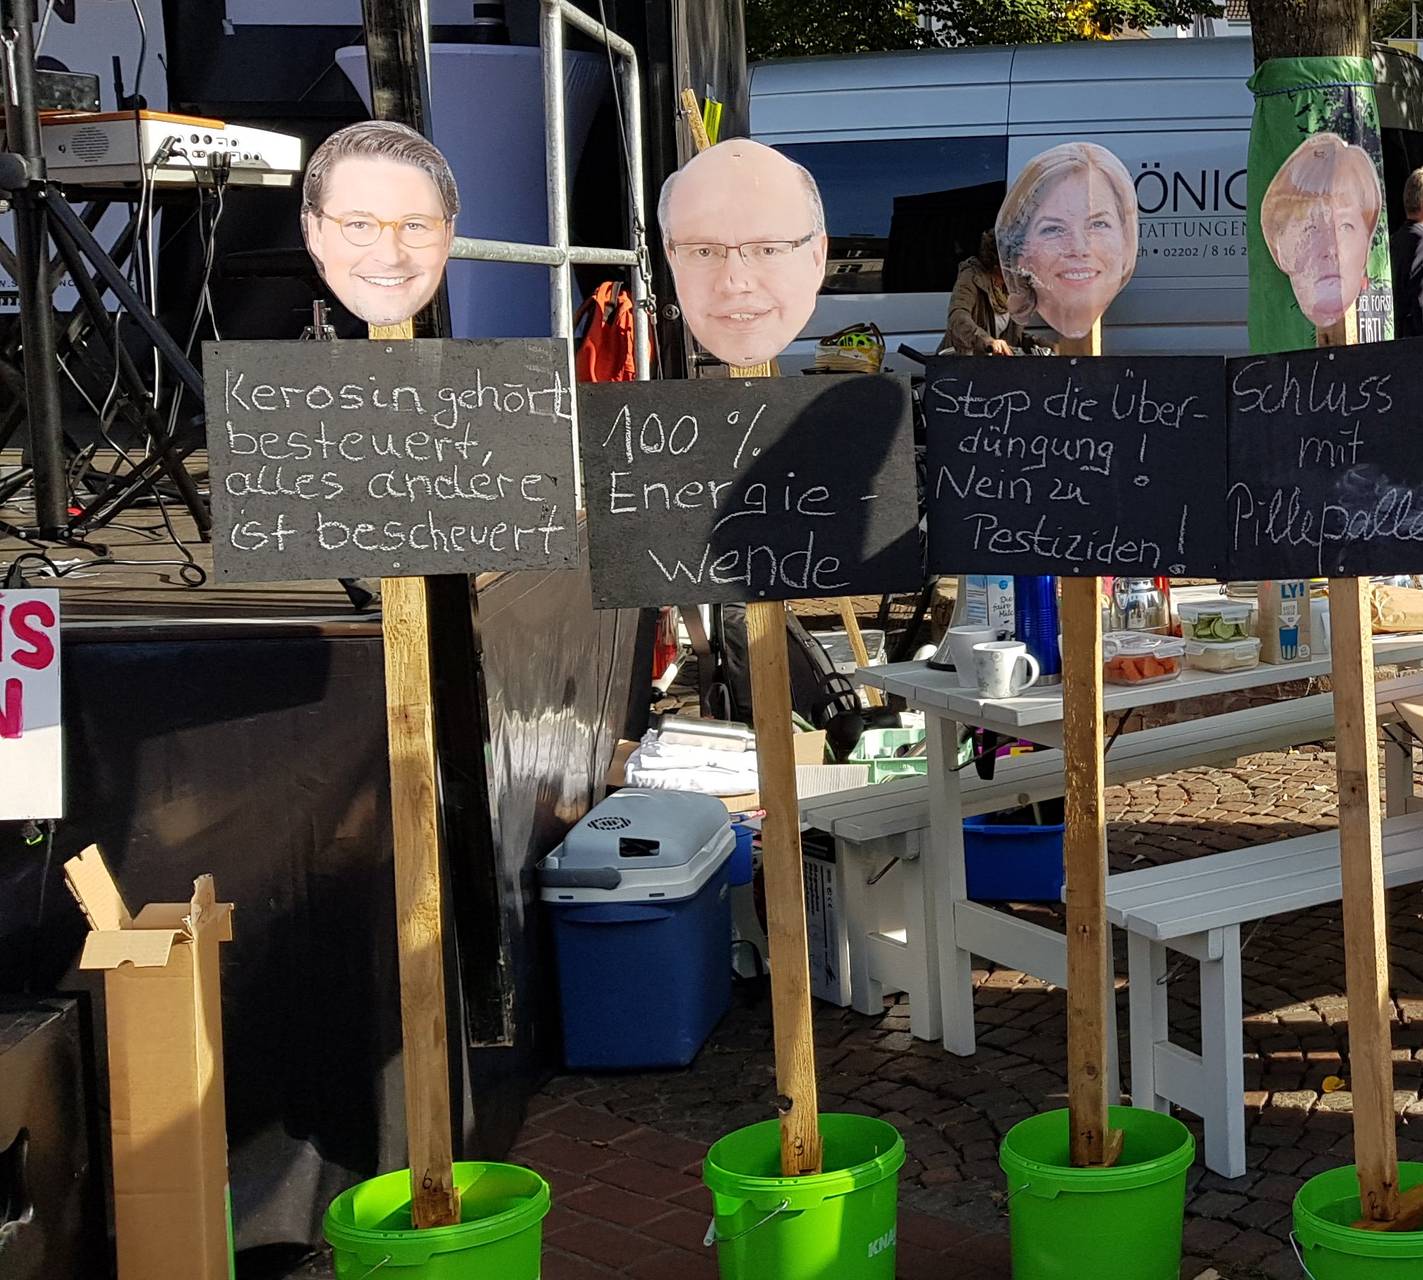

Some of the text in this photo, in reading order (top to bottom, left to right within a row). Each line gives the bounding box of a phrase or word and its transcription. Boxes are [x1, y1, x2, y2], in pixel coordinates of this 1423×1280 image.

[1138, 220, 1248, 238] TATTUNGE
[1164, 246, 1199, 257] 02202
[1212, 245, 1219, 256] 8
[1224, 244, 1236, 256] 16
[226, 368, 427, 414] Kerosin
[931, 378, 1031, 434] Stop
[1044, 377, 1098, 421] die
[1232, 360, 1393, 417] Schluss
[228, 421, 493, 467] besteuert,
[602, 404, 768, 469] 100 %
[1299, 420, 1364, 468] mit
[225, 465, 546, 502] alles andere
[610, 471, 836, 534] Energie
[936, 465, 1091, 506] Nein zu
[231, 504, 565, 554] ist bescheuert
